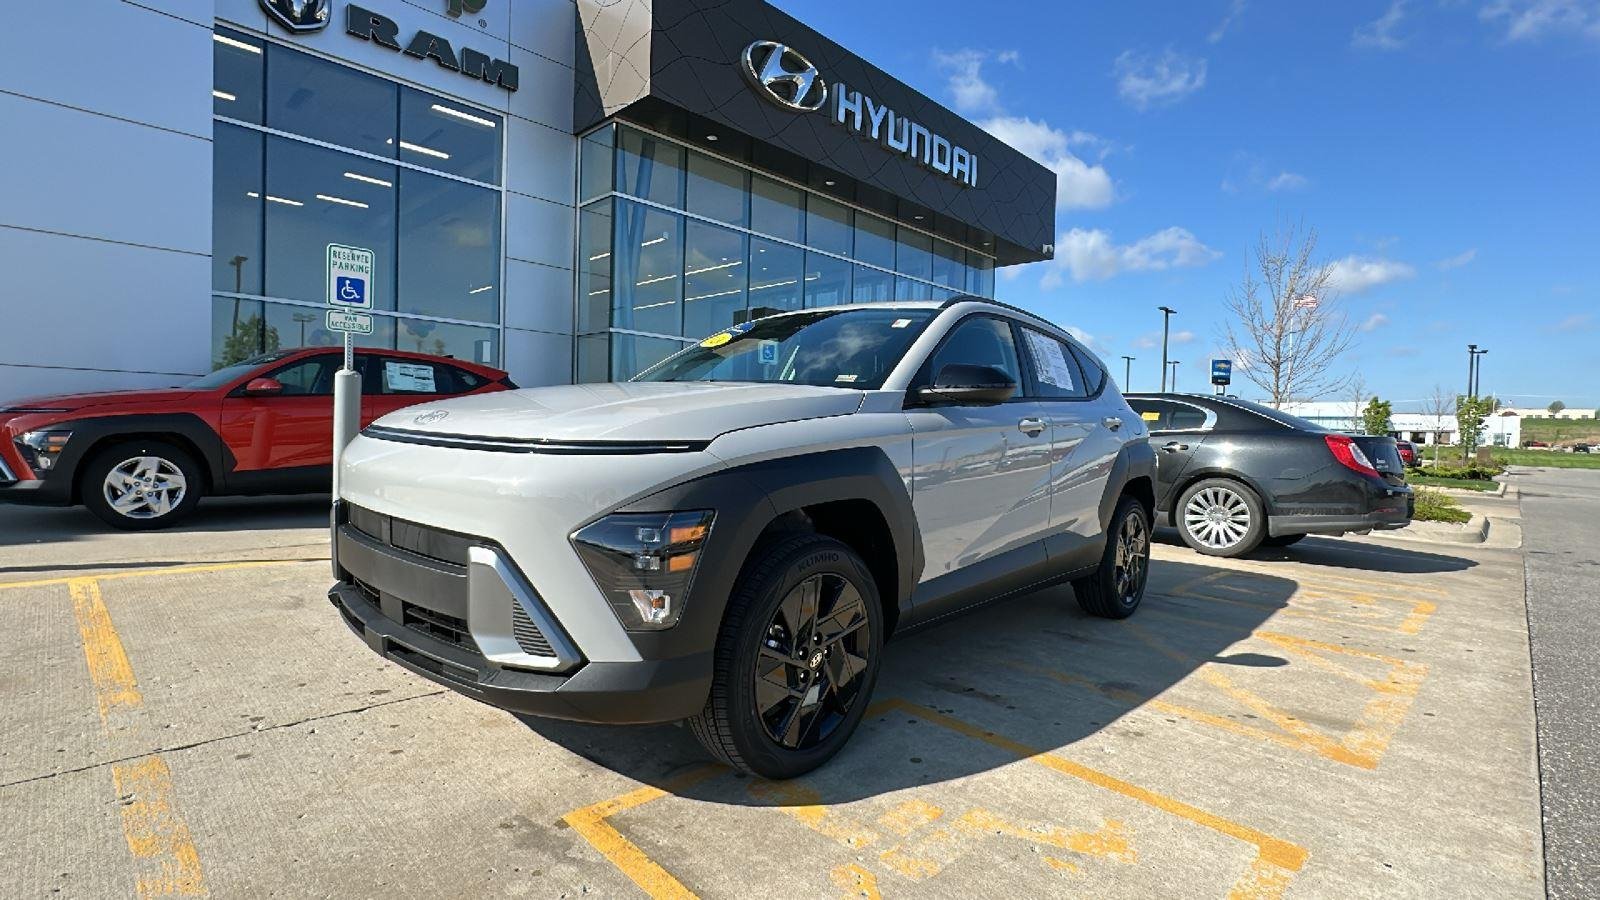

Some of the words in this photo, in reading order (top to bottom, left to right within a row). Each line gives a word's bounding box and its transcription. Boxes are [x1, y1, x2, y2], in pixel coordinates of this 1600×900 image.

[346, 3, 519, 91] RAM
[833, 82, 977, 187] HYUNDAI
[332, 250, 369, 264] RESERVED
[332, 260, 369, 274] PARKING
[331, 321, 370, 331] ACCESSIBLE
[798, 552, 839, 571] KUMHO
